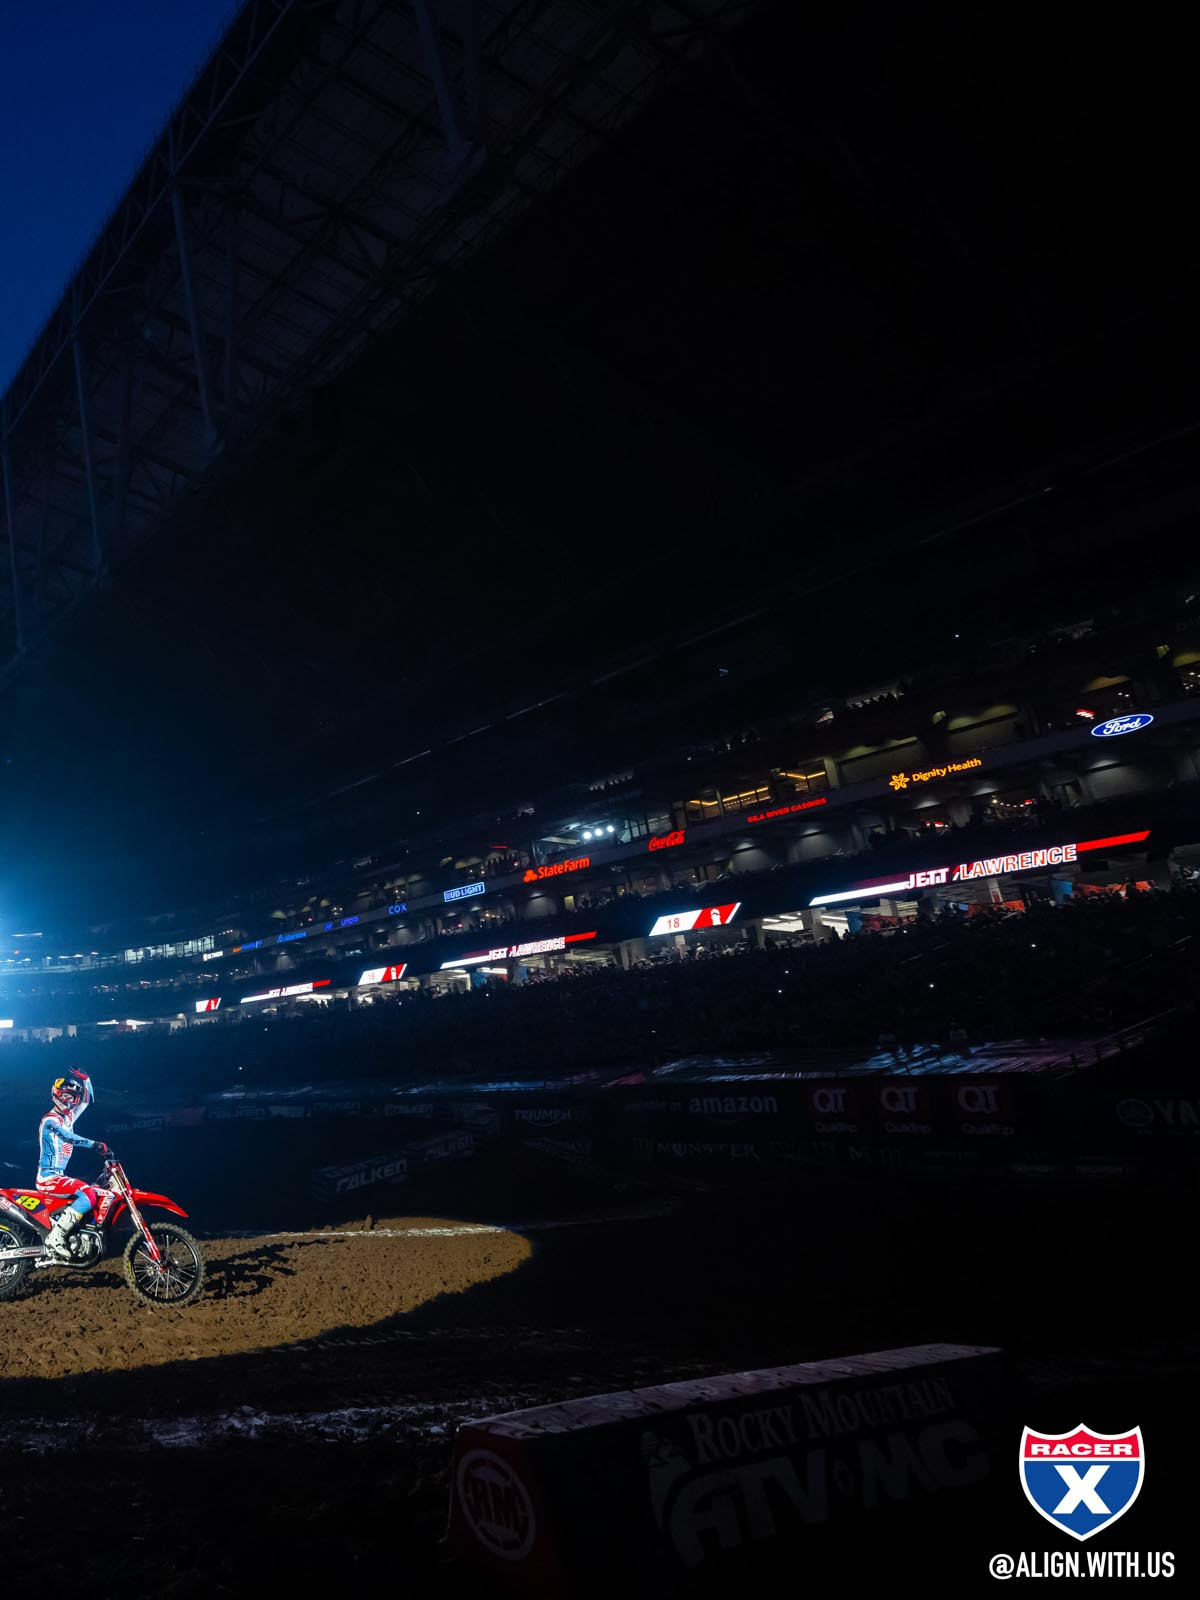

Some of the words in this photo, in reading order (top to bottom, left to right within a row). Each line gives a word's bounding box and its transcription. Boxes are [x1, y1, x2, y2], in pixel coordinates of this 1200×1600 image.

[1103, 717, 1141, 735] Ford
[912, 768, 947, 781] Dignity
[947, 758, 982, 772] Health
[766, 806, 790, 819] RIVER
[791, 797, 827, 812] CASINOS
[905, 868, 949, 889] JETT
[959, 844, 1077, 881] LAWRENCE
[461, 884, 483, 897] LIGHT
[388, 903, 407, 915] COX
[667, 917, 680, 929] 18
[688, 1095, 779, 1113] amazon
[814, 1088, 846, 1114] QT
[882, 1086, 918, 1114] QT
[958, 1085, 999, 1114] QT
[335, 1158, 407, 1194] FALKEN
[16, 1195, 40, 1210] 18
[686, 1404, 799, 1464] ROCKY
[798, 1376, 957, 1440] MOUNTAIN
[668, 1448, 830, 1569] ATV
[857, 1419, 992, 1512] MC
